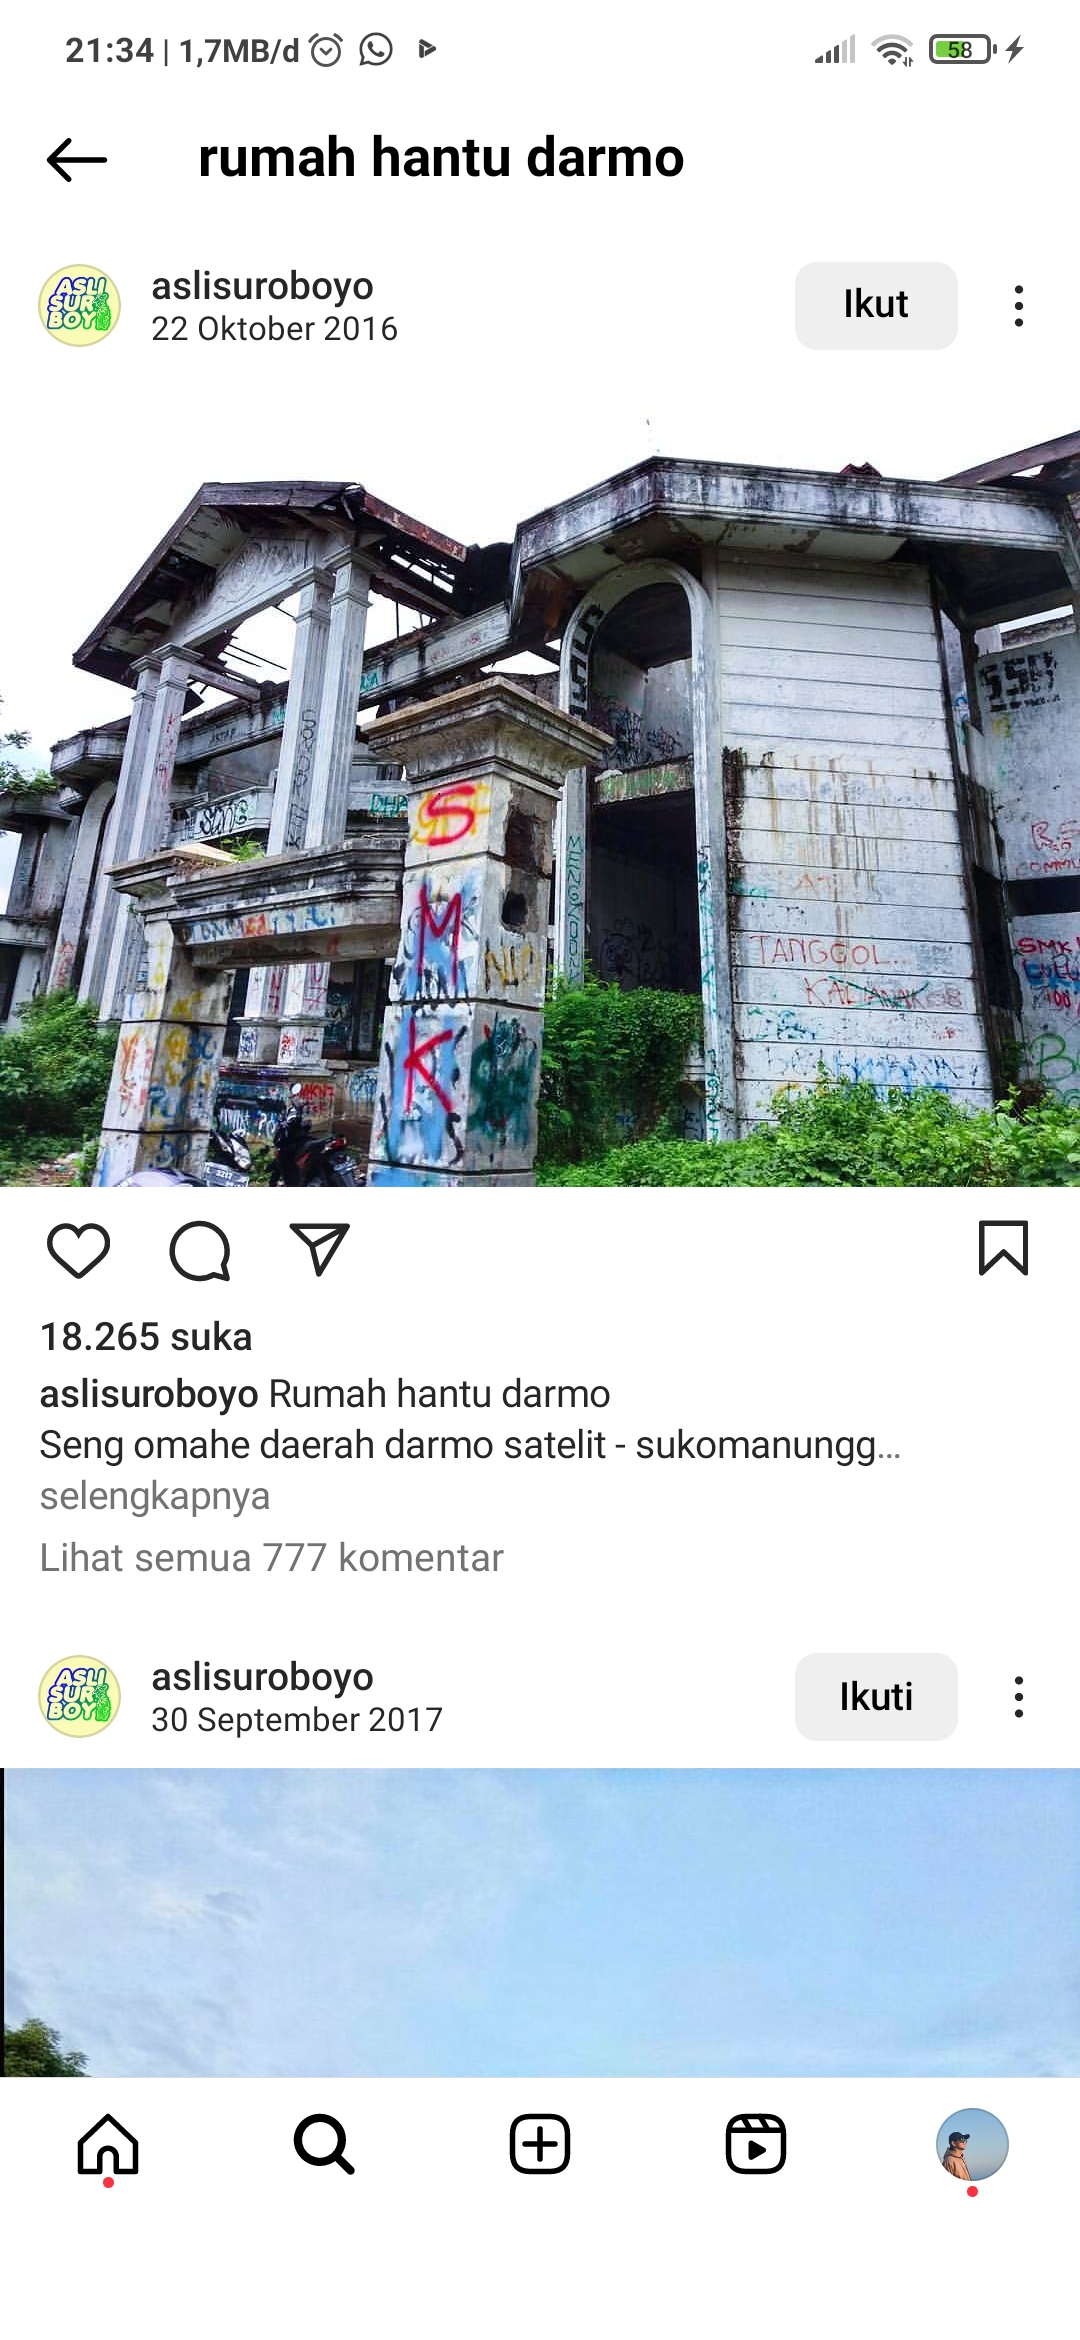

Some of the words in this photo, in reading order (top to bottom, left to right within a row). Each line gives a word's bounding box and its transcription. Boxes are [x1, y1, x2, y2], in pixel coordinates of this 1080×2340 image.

[66, 37, 154, 62] 21:34
[181, 38, 299, 68] 1,7MB/d
[948, 41, 972, 59] 58
[201, 135, 354, 178] rumah
[374, 135, 510, 178] hantu
[528, 135, 684, 178] darmo
[54, 276, 107, 295] ASLI
[152, 270, 374, 307] aslisuroboyo
[845, 288, 909, 318] Ikut
[151, 316, 188, 340] 22
[198, 315, 316, 341] Oktober
[324, 316, 398, 341] 2016
[42, 1321, 159, 1351] 18.265
[171, 1320, 252, 1352] suka
[40, 1377, 259, 1416] aslisuroboyo
[270, 1377, 386, 1409] Rumah
[398, 1377, 491, 1409] hantu
[502, 1377, 611, 1409] darmo
[40, 1429, 123, 1467] Seng
[134, 1428, 250, 1460] omahe
[260, 1428, 374, 1460] daerah
[385, 1428, 494, 1460] darmo
[504, 1428, 607, 1460] satelit
[40, 1479, 270, 1518] selengkapnya
[41, 1540, 123, 1572] Lihat
[135, 1548, 251, 1572] semua
[262, 1542, 327, 1572] 777
[340, 1540, 505, 1572] komentar
[54, 1667, 107, 1685] ASLI
[152, 1660, 374, 1699] aslisuroboyo
[841, 1680, 913, 1712] Ikuti
[151, 1706, 188, 1732] 30
[197, 1705, 361, 1739] September
[369, 1706, 443, 1732] 2017
